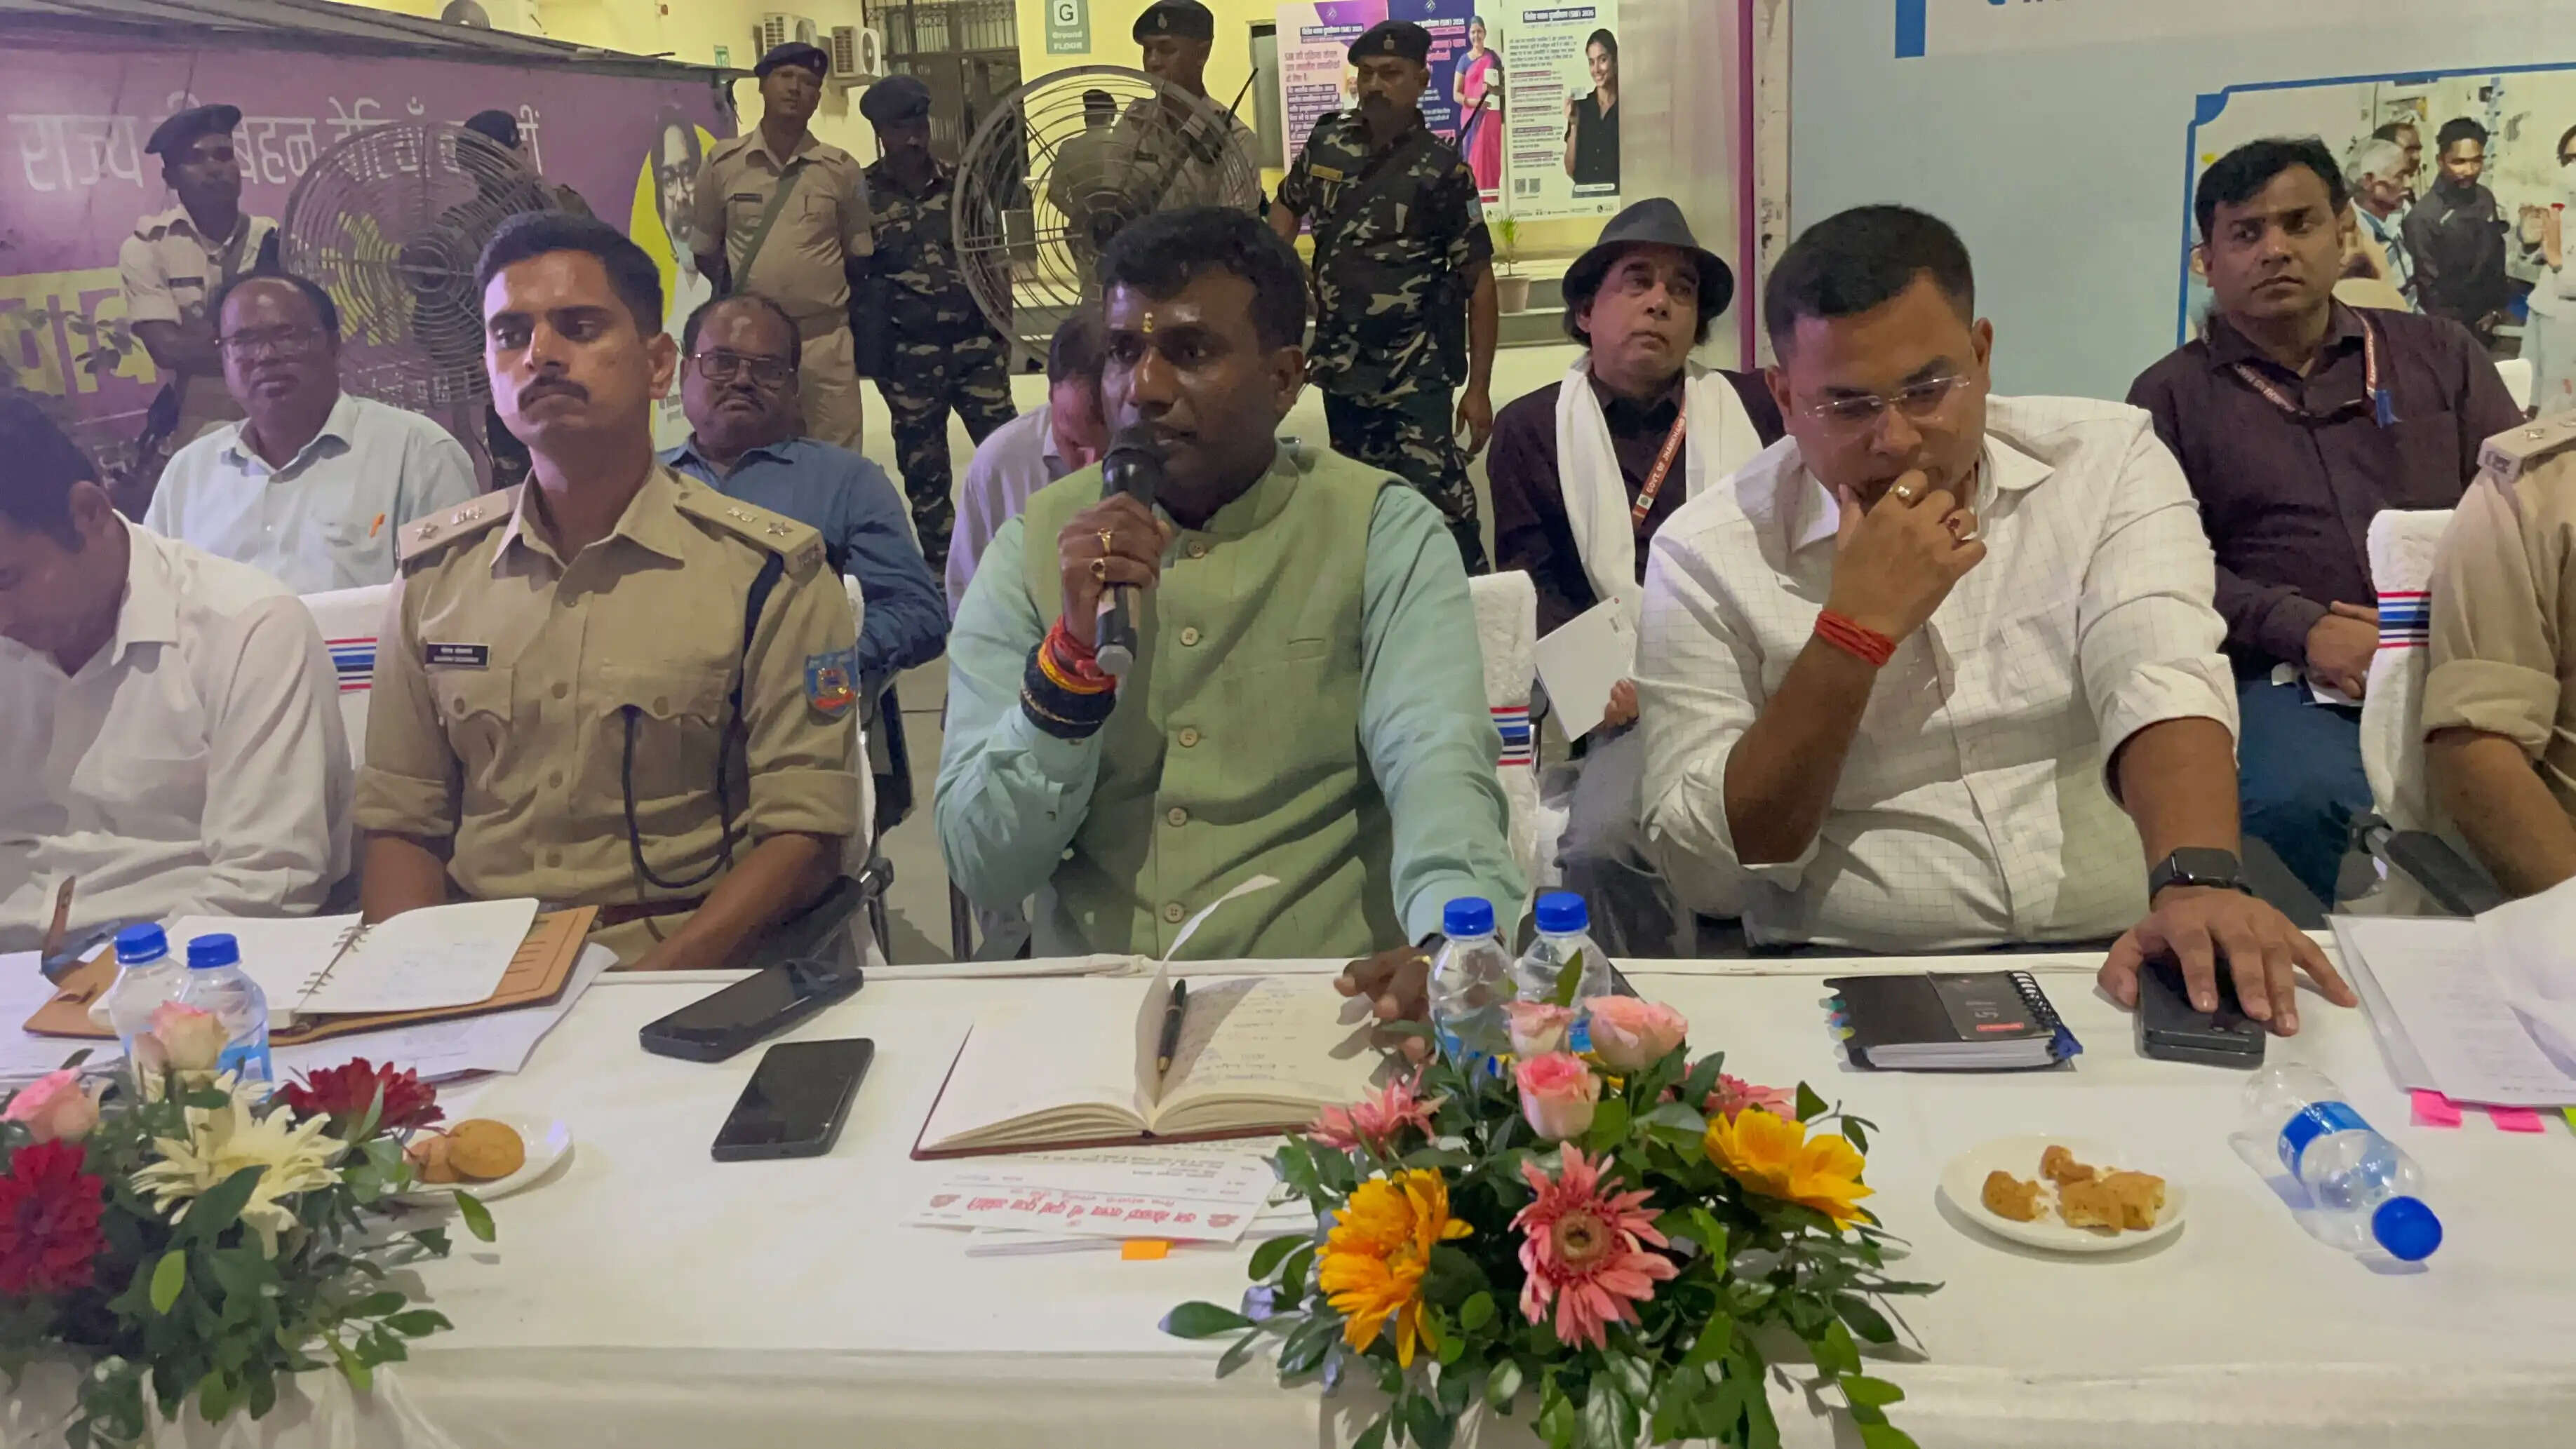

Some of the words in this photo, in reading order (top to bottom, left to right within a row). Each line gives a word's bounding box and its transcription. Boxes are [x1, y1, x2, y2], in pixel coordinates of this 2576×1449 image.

[1059, 4, 1074, 22] G
[1054, 42, 1083, 50] FLOOR
[6, 112, 144, 191] राज्य
